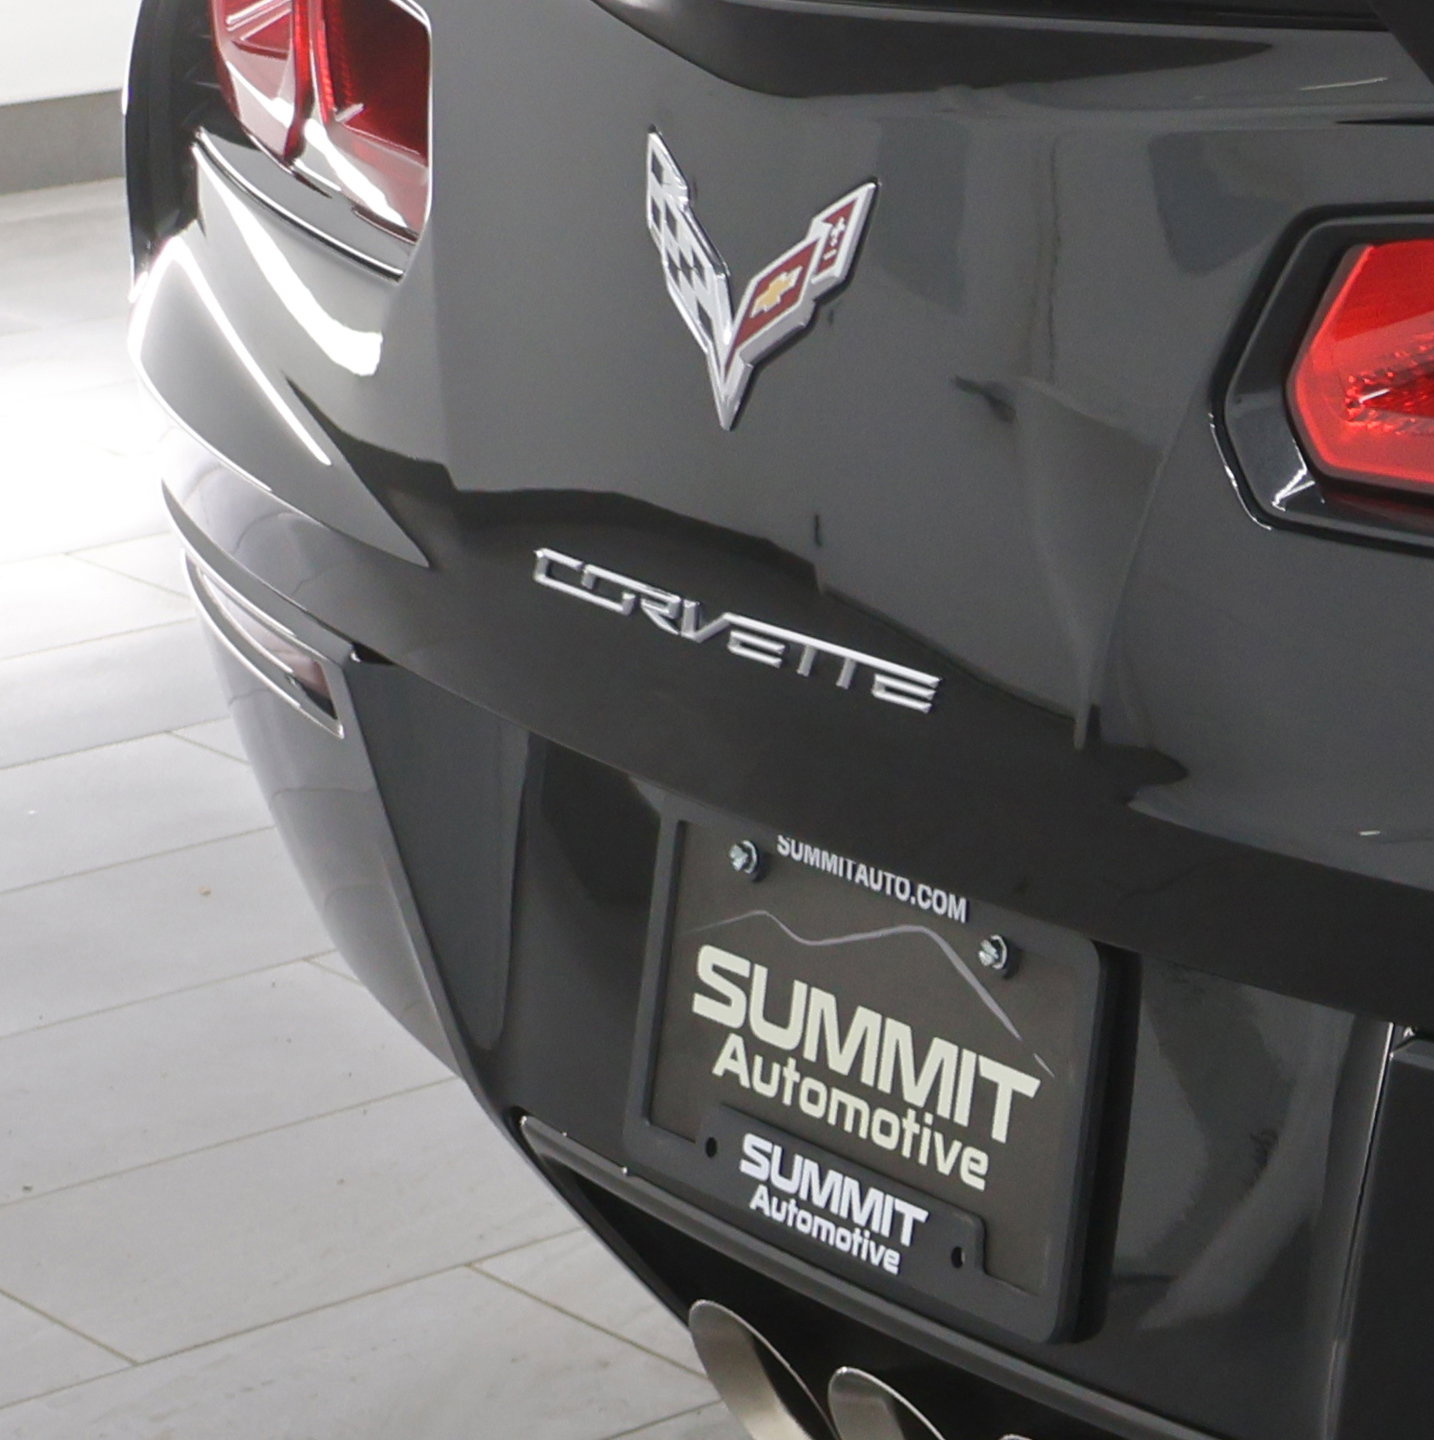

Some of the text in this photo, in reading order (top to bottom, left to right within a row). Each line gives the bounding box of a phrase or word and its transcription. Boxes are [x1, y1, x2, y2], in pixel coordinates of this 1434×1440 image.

[533, 547, 942, 714] CORVETTE
[776, 834, 968, 924] SUMMITAUTO.COM
[692, 944, 1041, 1144] SUMMIT
[711, 1032, 989, 1192] Automotive
[739, 1132, 929, 1247] SUMMIT
[749, 1184, 901, 1276] Automotive
